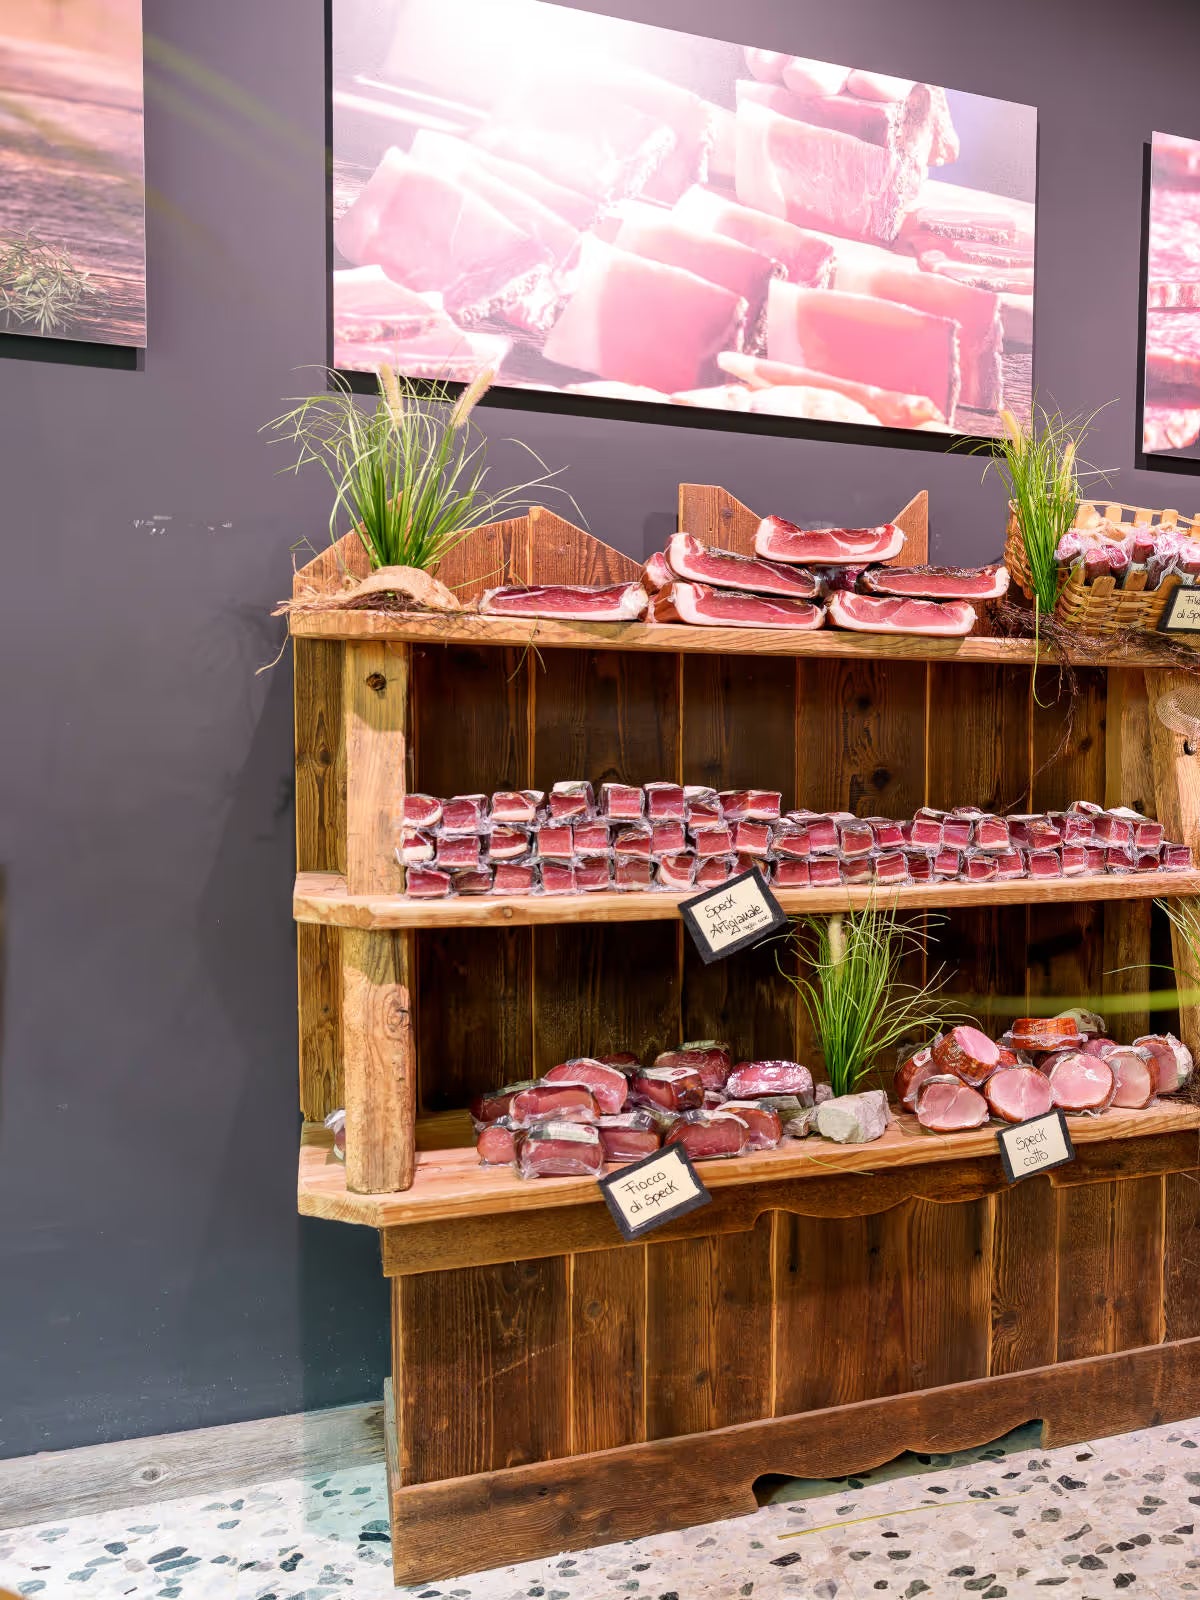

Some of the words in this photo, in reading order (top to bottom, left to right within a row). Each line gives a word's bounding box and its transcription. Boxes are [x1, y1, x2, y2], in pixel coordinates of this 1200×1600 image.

[1176, 608, 1186, 619] di
[704, 894, 737, 920] Speck
[1016, 1127, 1047, 1153] Speck
[1023, 1148, 1049, 1166] cotto
[620, 1172, 667, 1195] Fiocco
[630, 1200, 643, 1214] di
[644, 1180, 679, 1207] Speck
